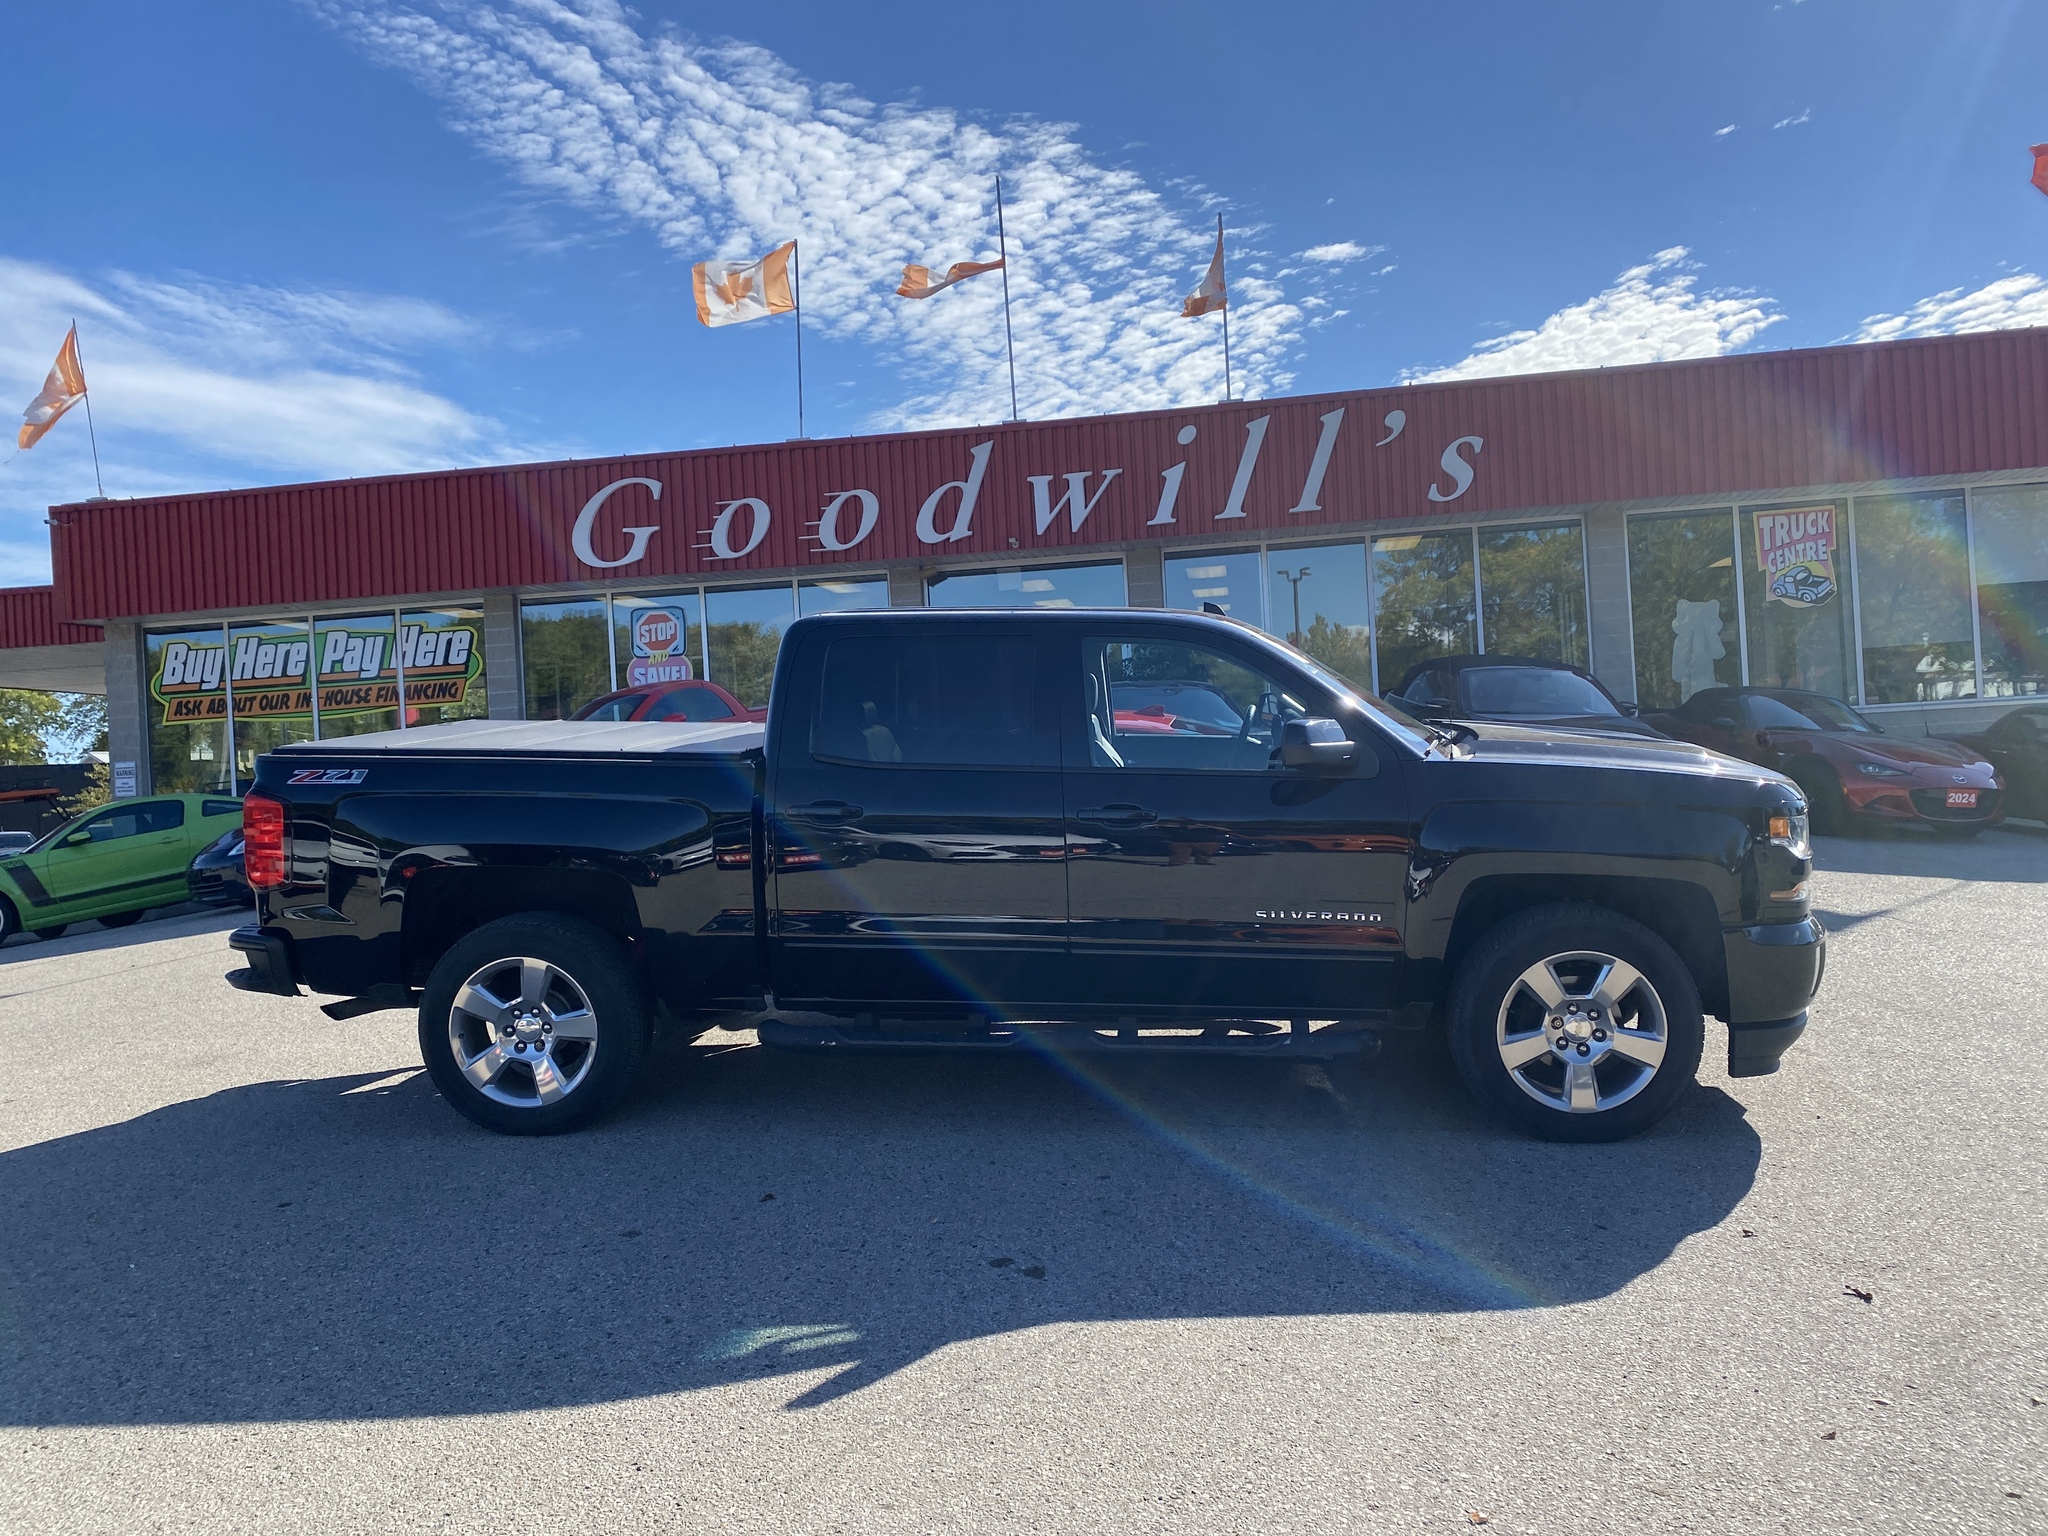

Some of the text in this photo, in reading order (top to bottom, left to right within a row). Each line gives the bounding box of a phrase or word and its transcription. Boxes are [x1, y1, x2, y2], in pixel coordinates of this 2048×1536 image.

[571, 406, 1485, 569] Goodwill's
[1759, 511, 1830, 551] TRUCK
[1767, 538, 1828, 573] CENTRE
[640, 621, 676, 643] STOP
[162, 625, 471, 690] Buy Here Pay Here
[648, 650, 669, 665] AND
[174, 699, 202, 716] ASK
[206, 695, 258, 715] ABOUT
[259, 693, 290, 711] OUR
[375, 681, 458, 702] FINANCING
[286, 769, 369, 784] Z71
[1948, 793, 1976, 804] 2024
[1255, 910, 1382, 922] SILVERADO
